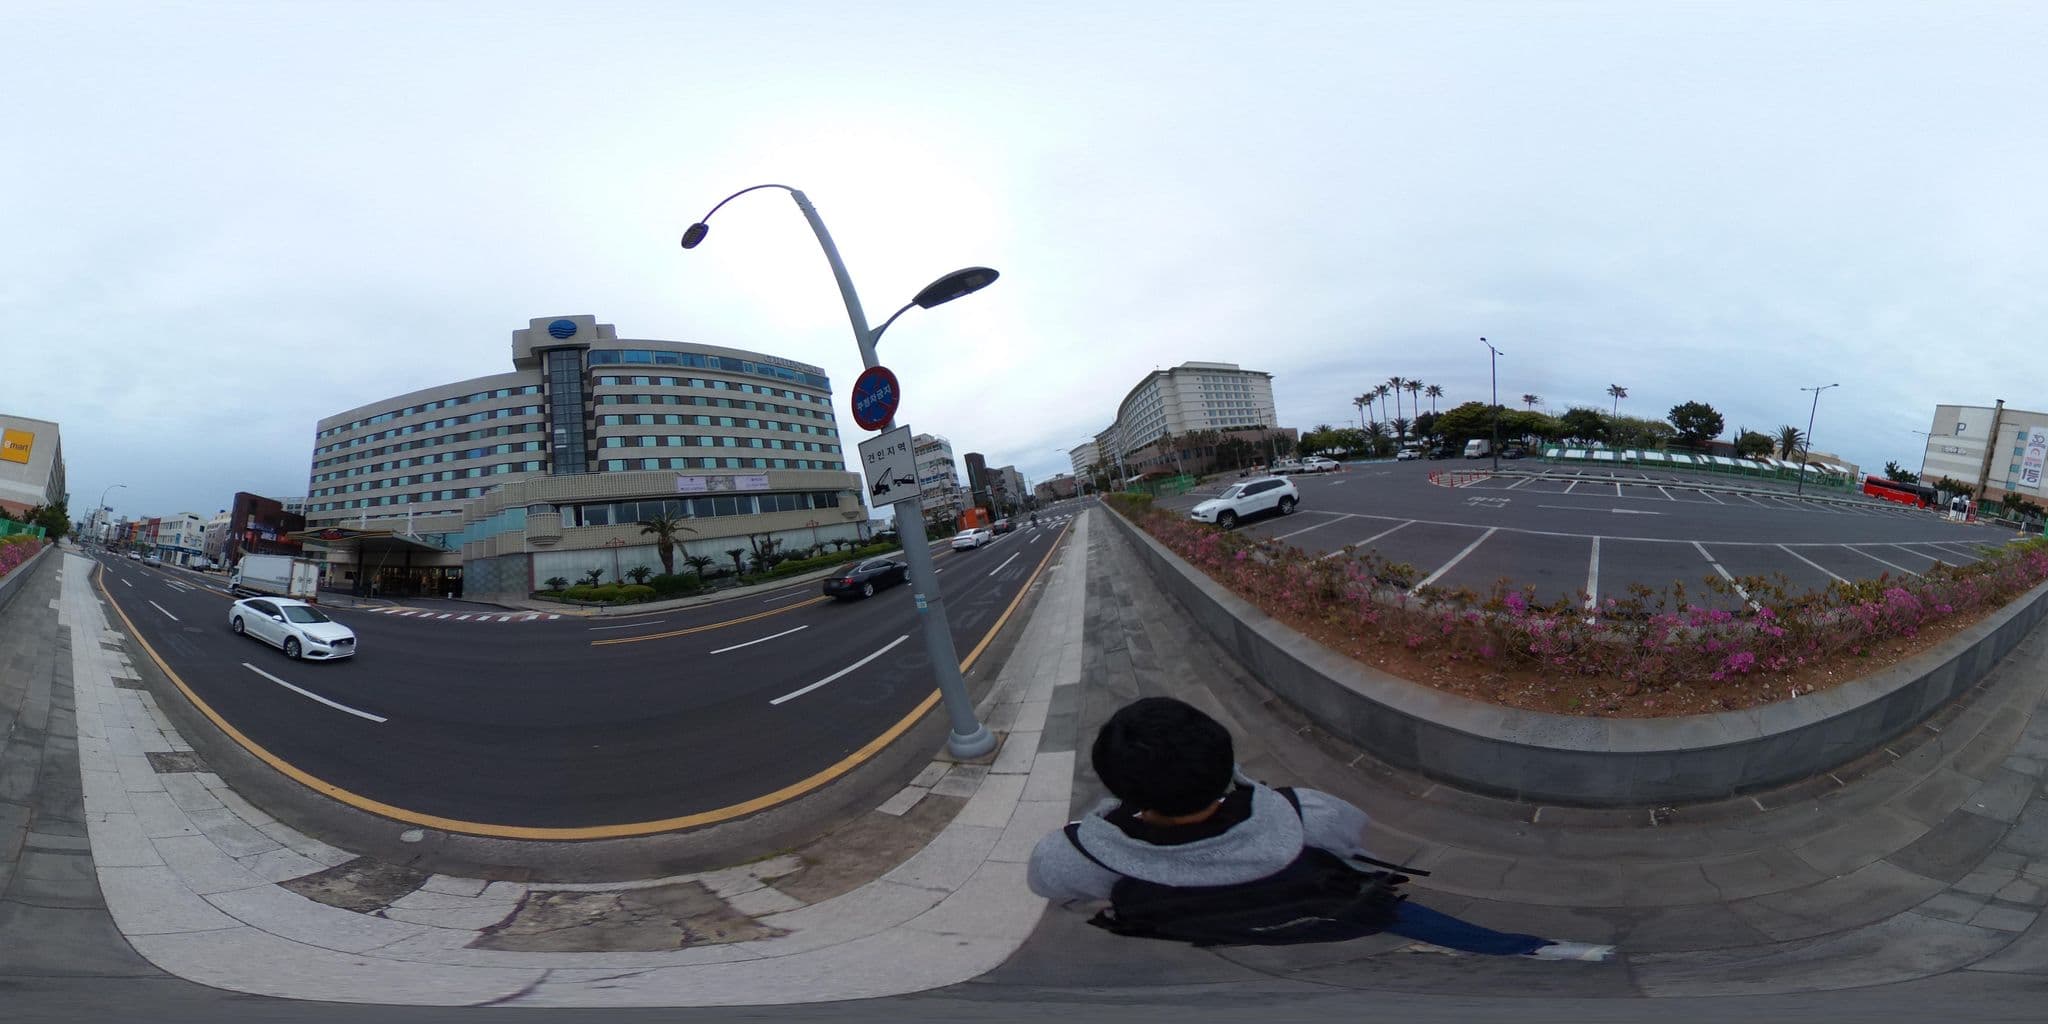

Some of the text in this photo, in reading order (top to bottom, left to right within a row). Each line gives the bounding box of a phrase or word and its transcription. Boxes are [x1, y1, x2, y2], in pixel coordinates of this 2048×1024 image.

[857, 384, 891, 411] 주정차금지
[1955, 423, 1966, 435] P
[5, 440, 28, 450] emart
[867, 442, 906, 463] 견인지역
